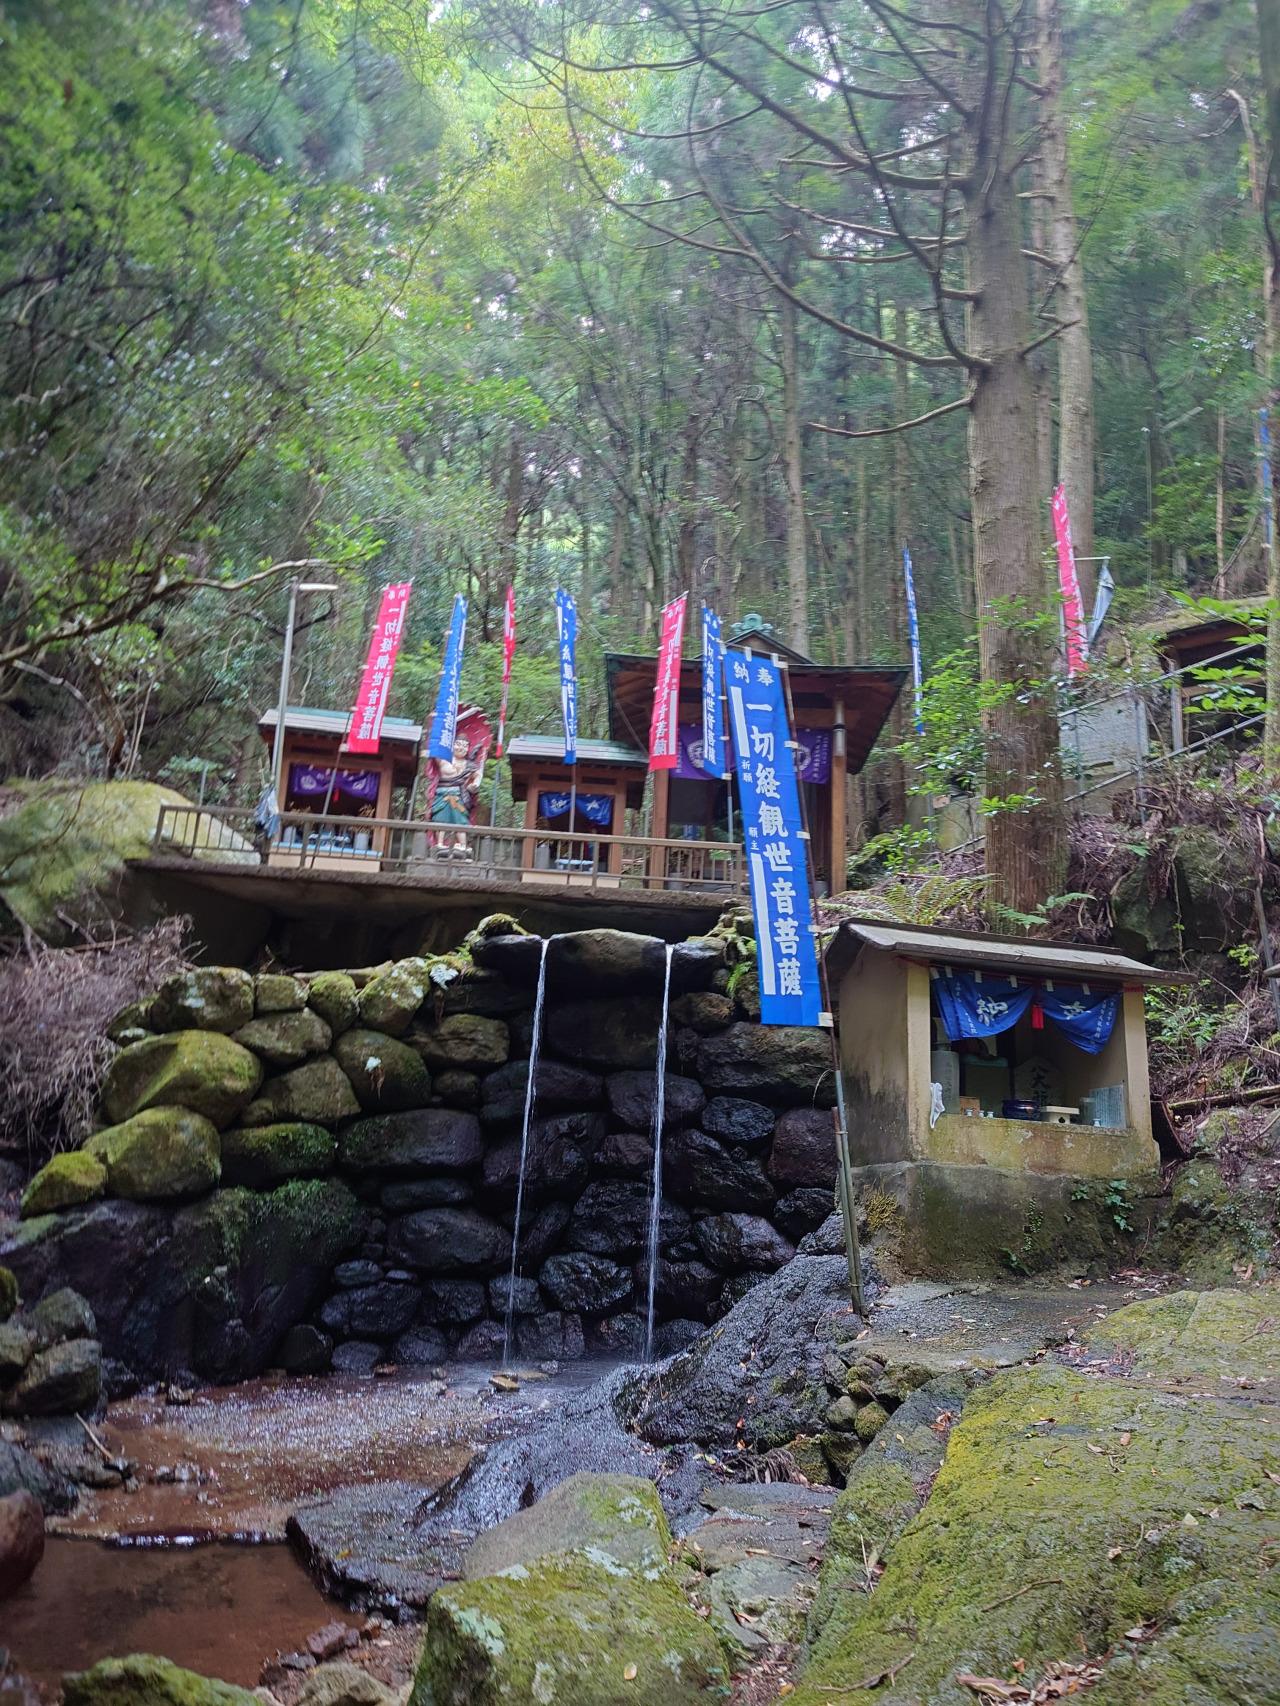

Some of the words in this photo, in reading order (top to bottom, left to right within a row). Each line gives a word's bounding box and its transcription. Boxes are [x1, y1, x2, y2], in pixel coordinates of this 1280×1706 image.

[742, 760, 753, 783] 祈願
[746, 703, 803, 996] 一切経観世音菩薩
